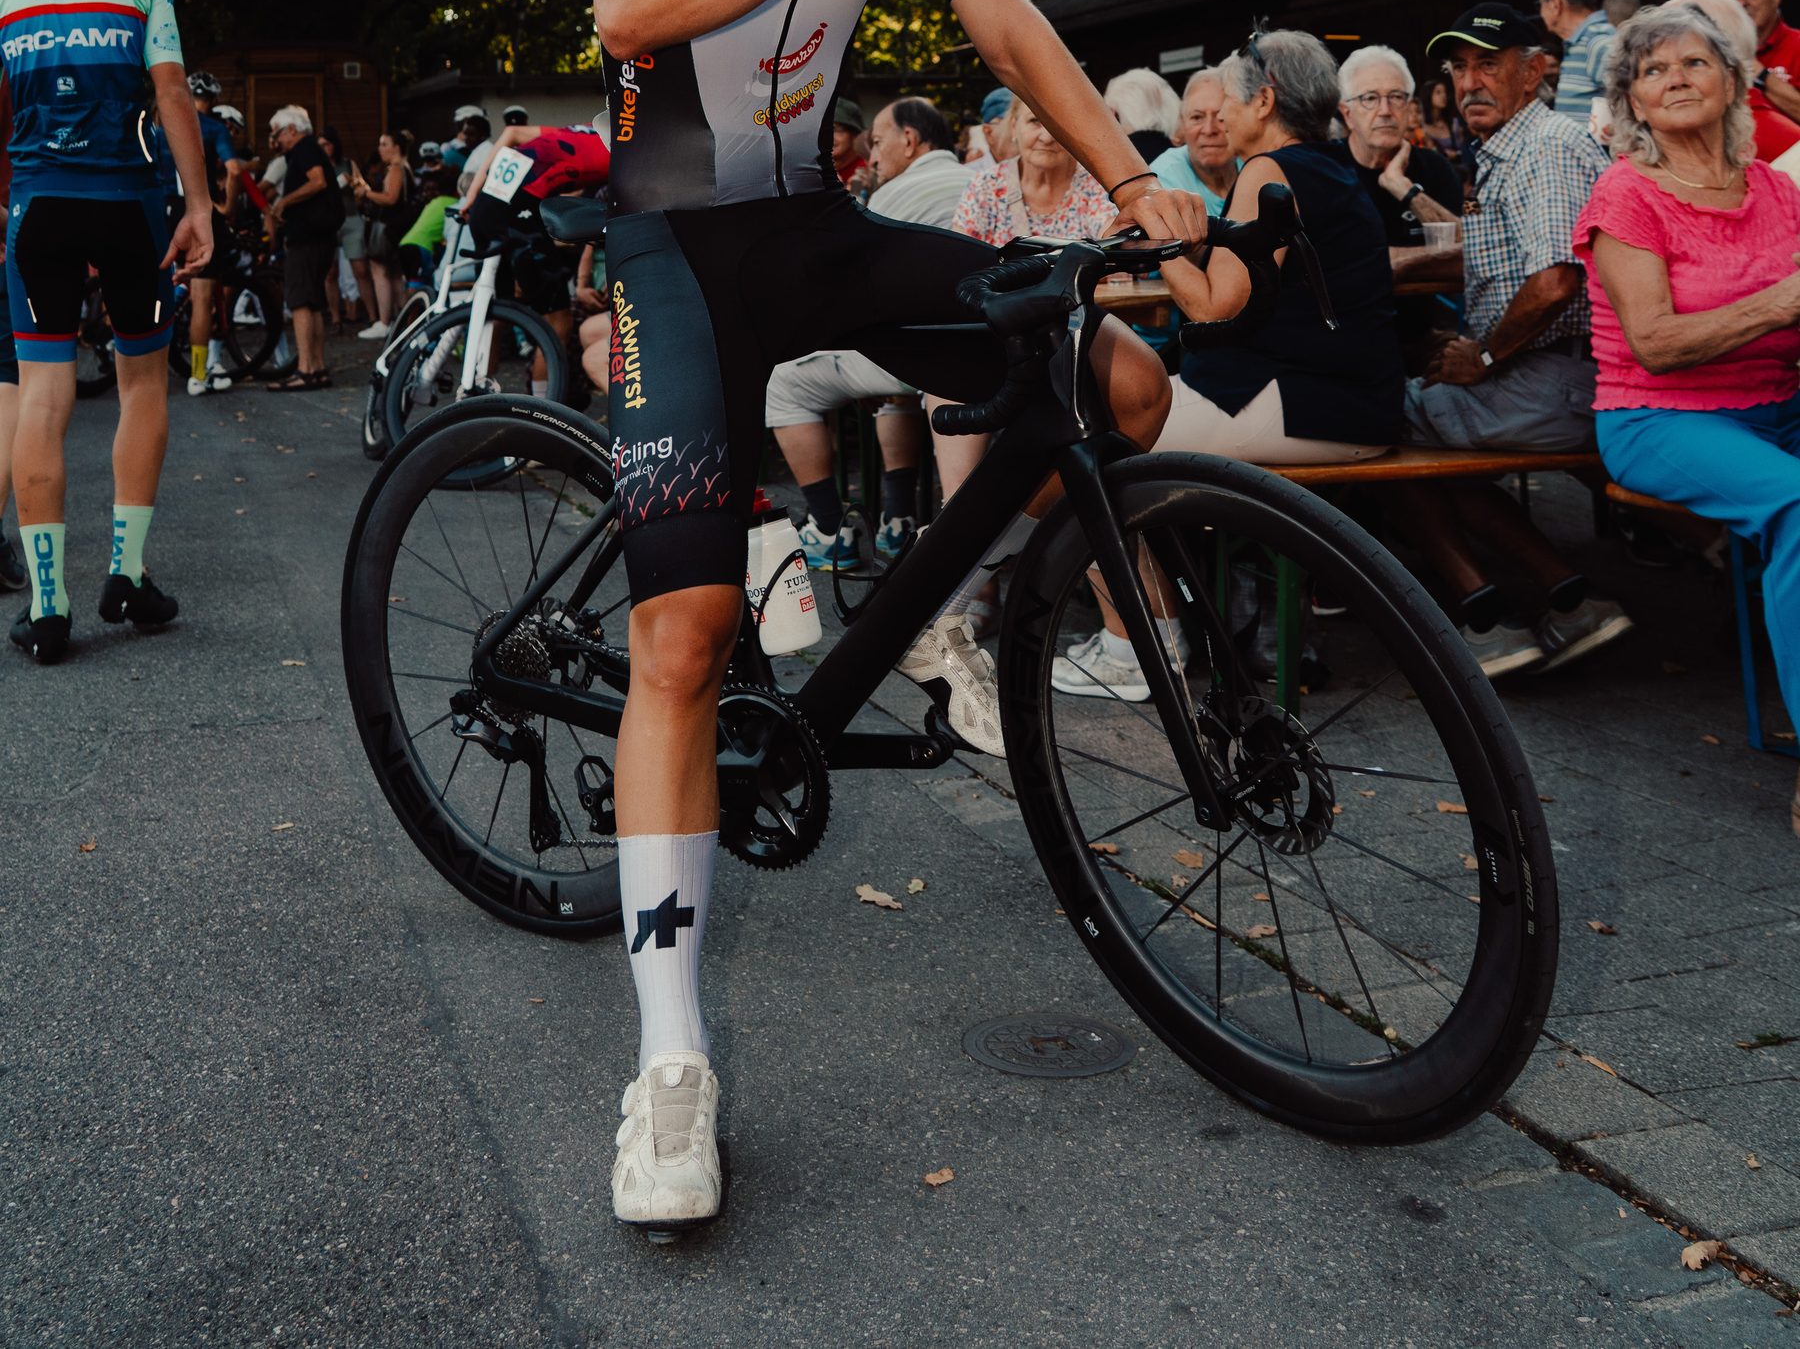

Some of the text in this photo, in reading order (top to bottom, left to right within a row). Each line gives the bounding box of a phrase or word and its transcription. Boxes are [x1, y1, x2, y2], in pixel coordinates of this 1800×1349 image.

[2, 27, 133, 60] RRC-AMT
[753, 72, 824, 125] Goldwurst
[495, 157, 519, 184] 56
[613, 281, 647, 408] Goldwurst
[532, 411, 568, 429] GRAND
[566, 426, 592, 443] PRIX
[34, 532, 57, 617] RRC
[1520, 850, 1534, 912] AERO
